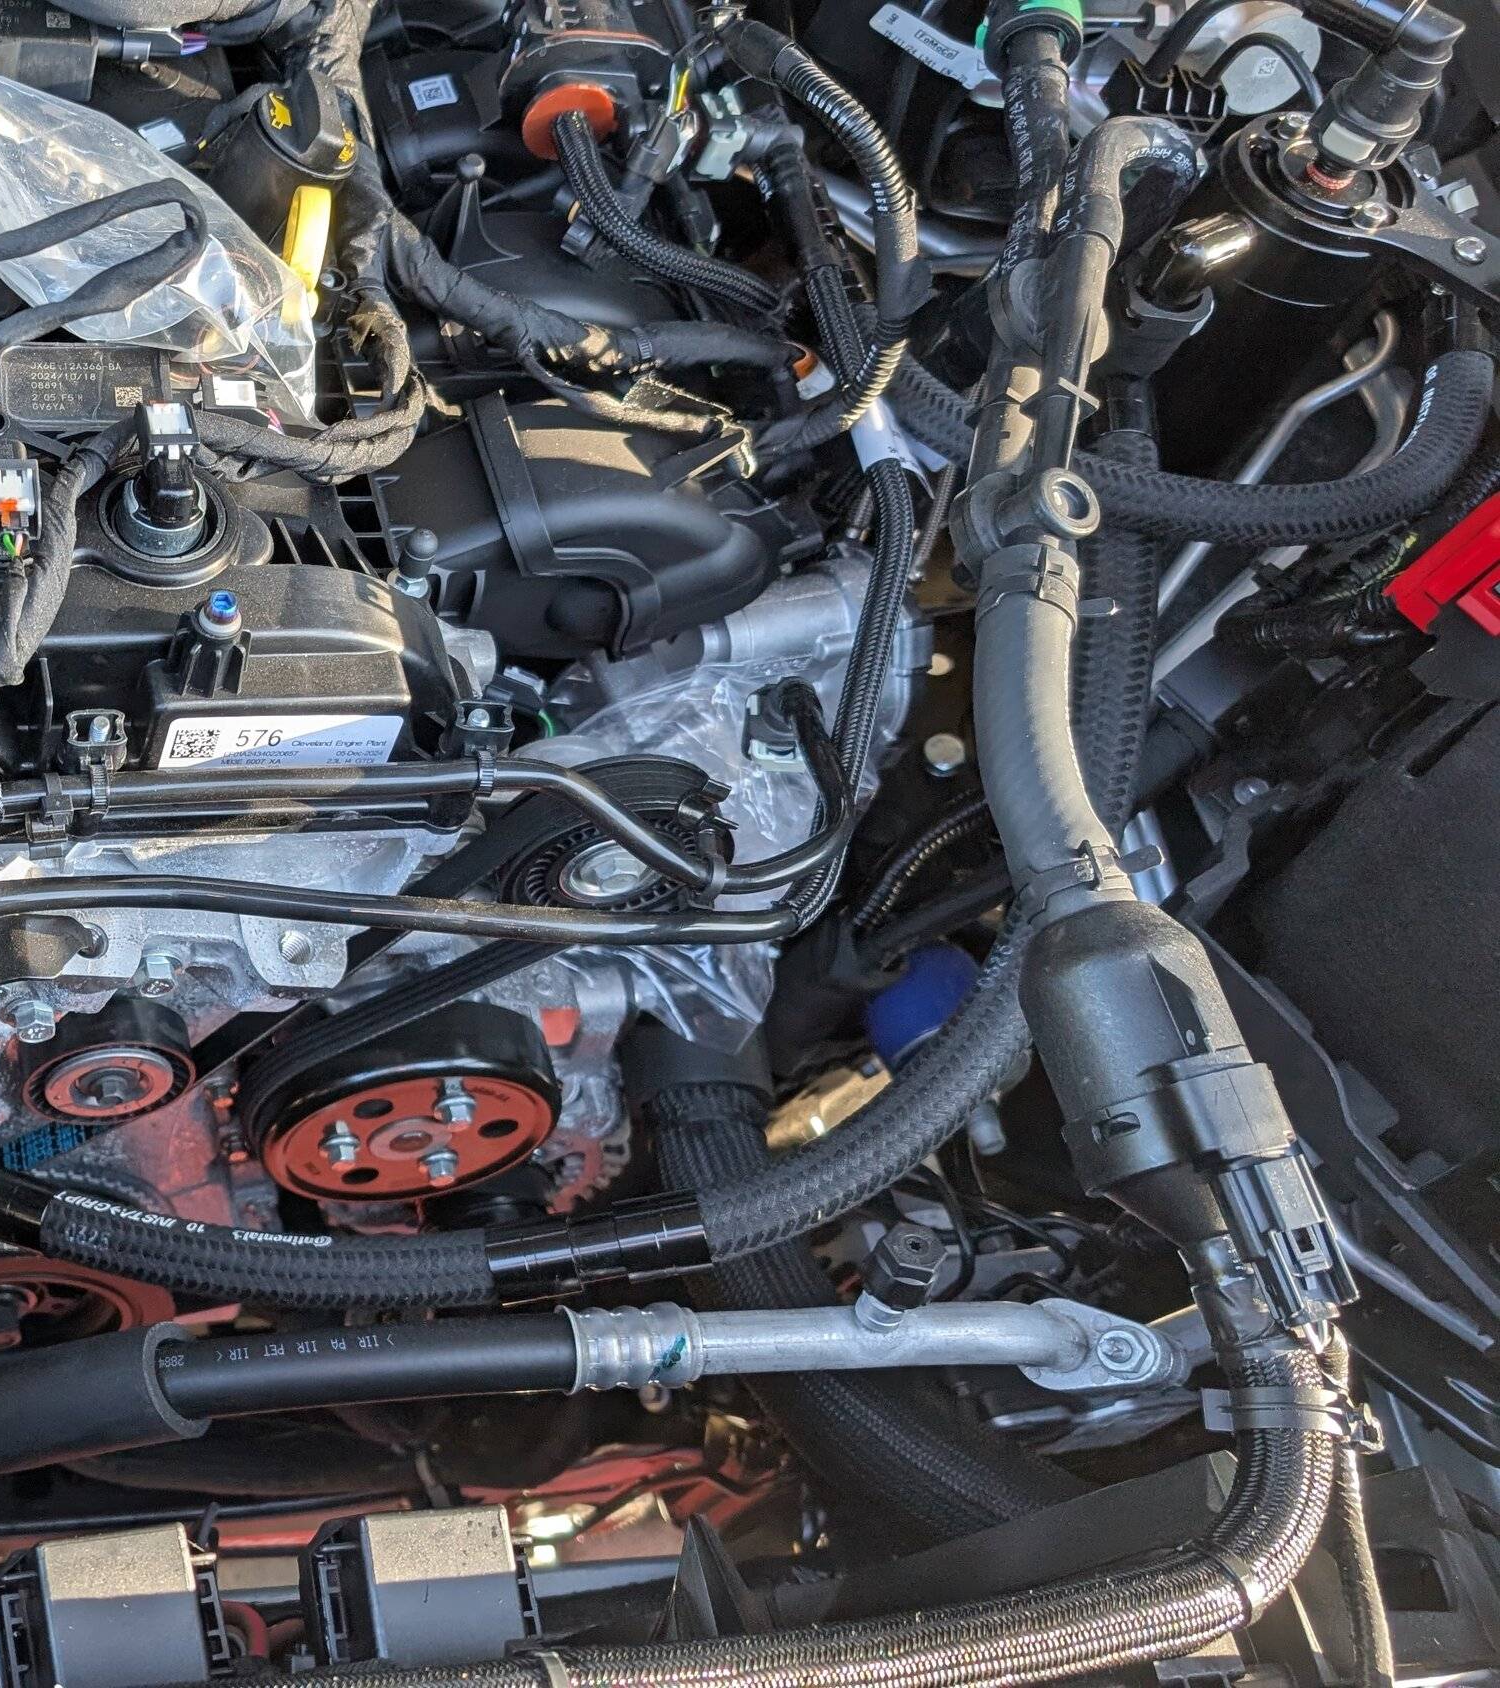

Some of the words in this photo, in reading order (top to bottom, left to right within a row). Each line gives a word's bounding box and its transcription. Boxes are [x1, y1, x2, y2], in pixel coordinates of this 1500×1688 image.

[30, 373, 97, 381] 2024/10/18
[235, 729, 284, 747] 576
[335, 740, 363, 748] Engine
[186, 1222, 206, 1234] 10
[298, 1340, 318, 1354] IIR
[330, 1338, 347, 1350] PA
[357, 1334, 379, 1349] IIR
[229, 1347, 250, 1361] IIR
[264, 1344, 285, 1357] PET
